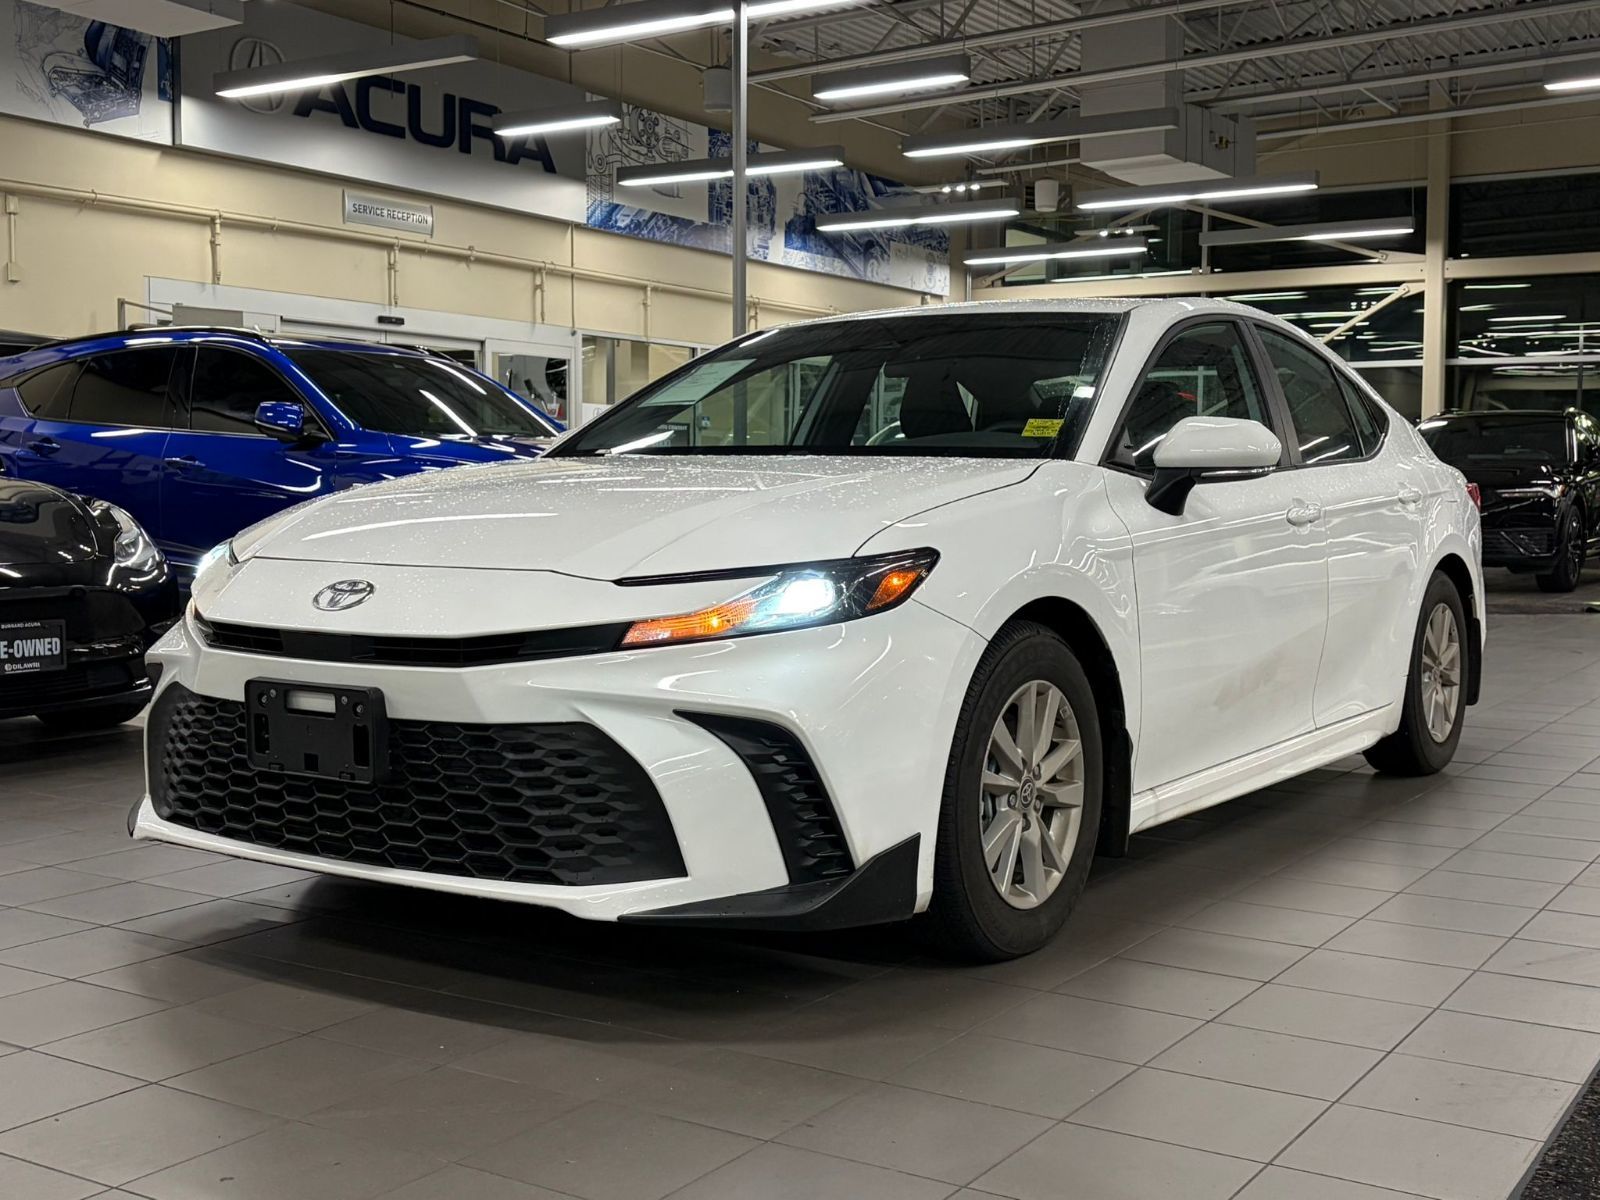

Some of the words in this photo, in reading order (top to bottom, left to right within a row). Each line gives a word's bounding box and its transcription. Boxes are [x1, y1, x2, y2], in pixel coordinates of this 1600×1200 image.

[292, 74, 557, 174] ACURA
[352, 203, 385, 218] SERVICE
[387, 208, 428, 225] RECEPTION
